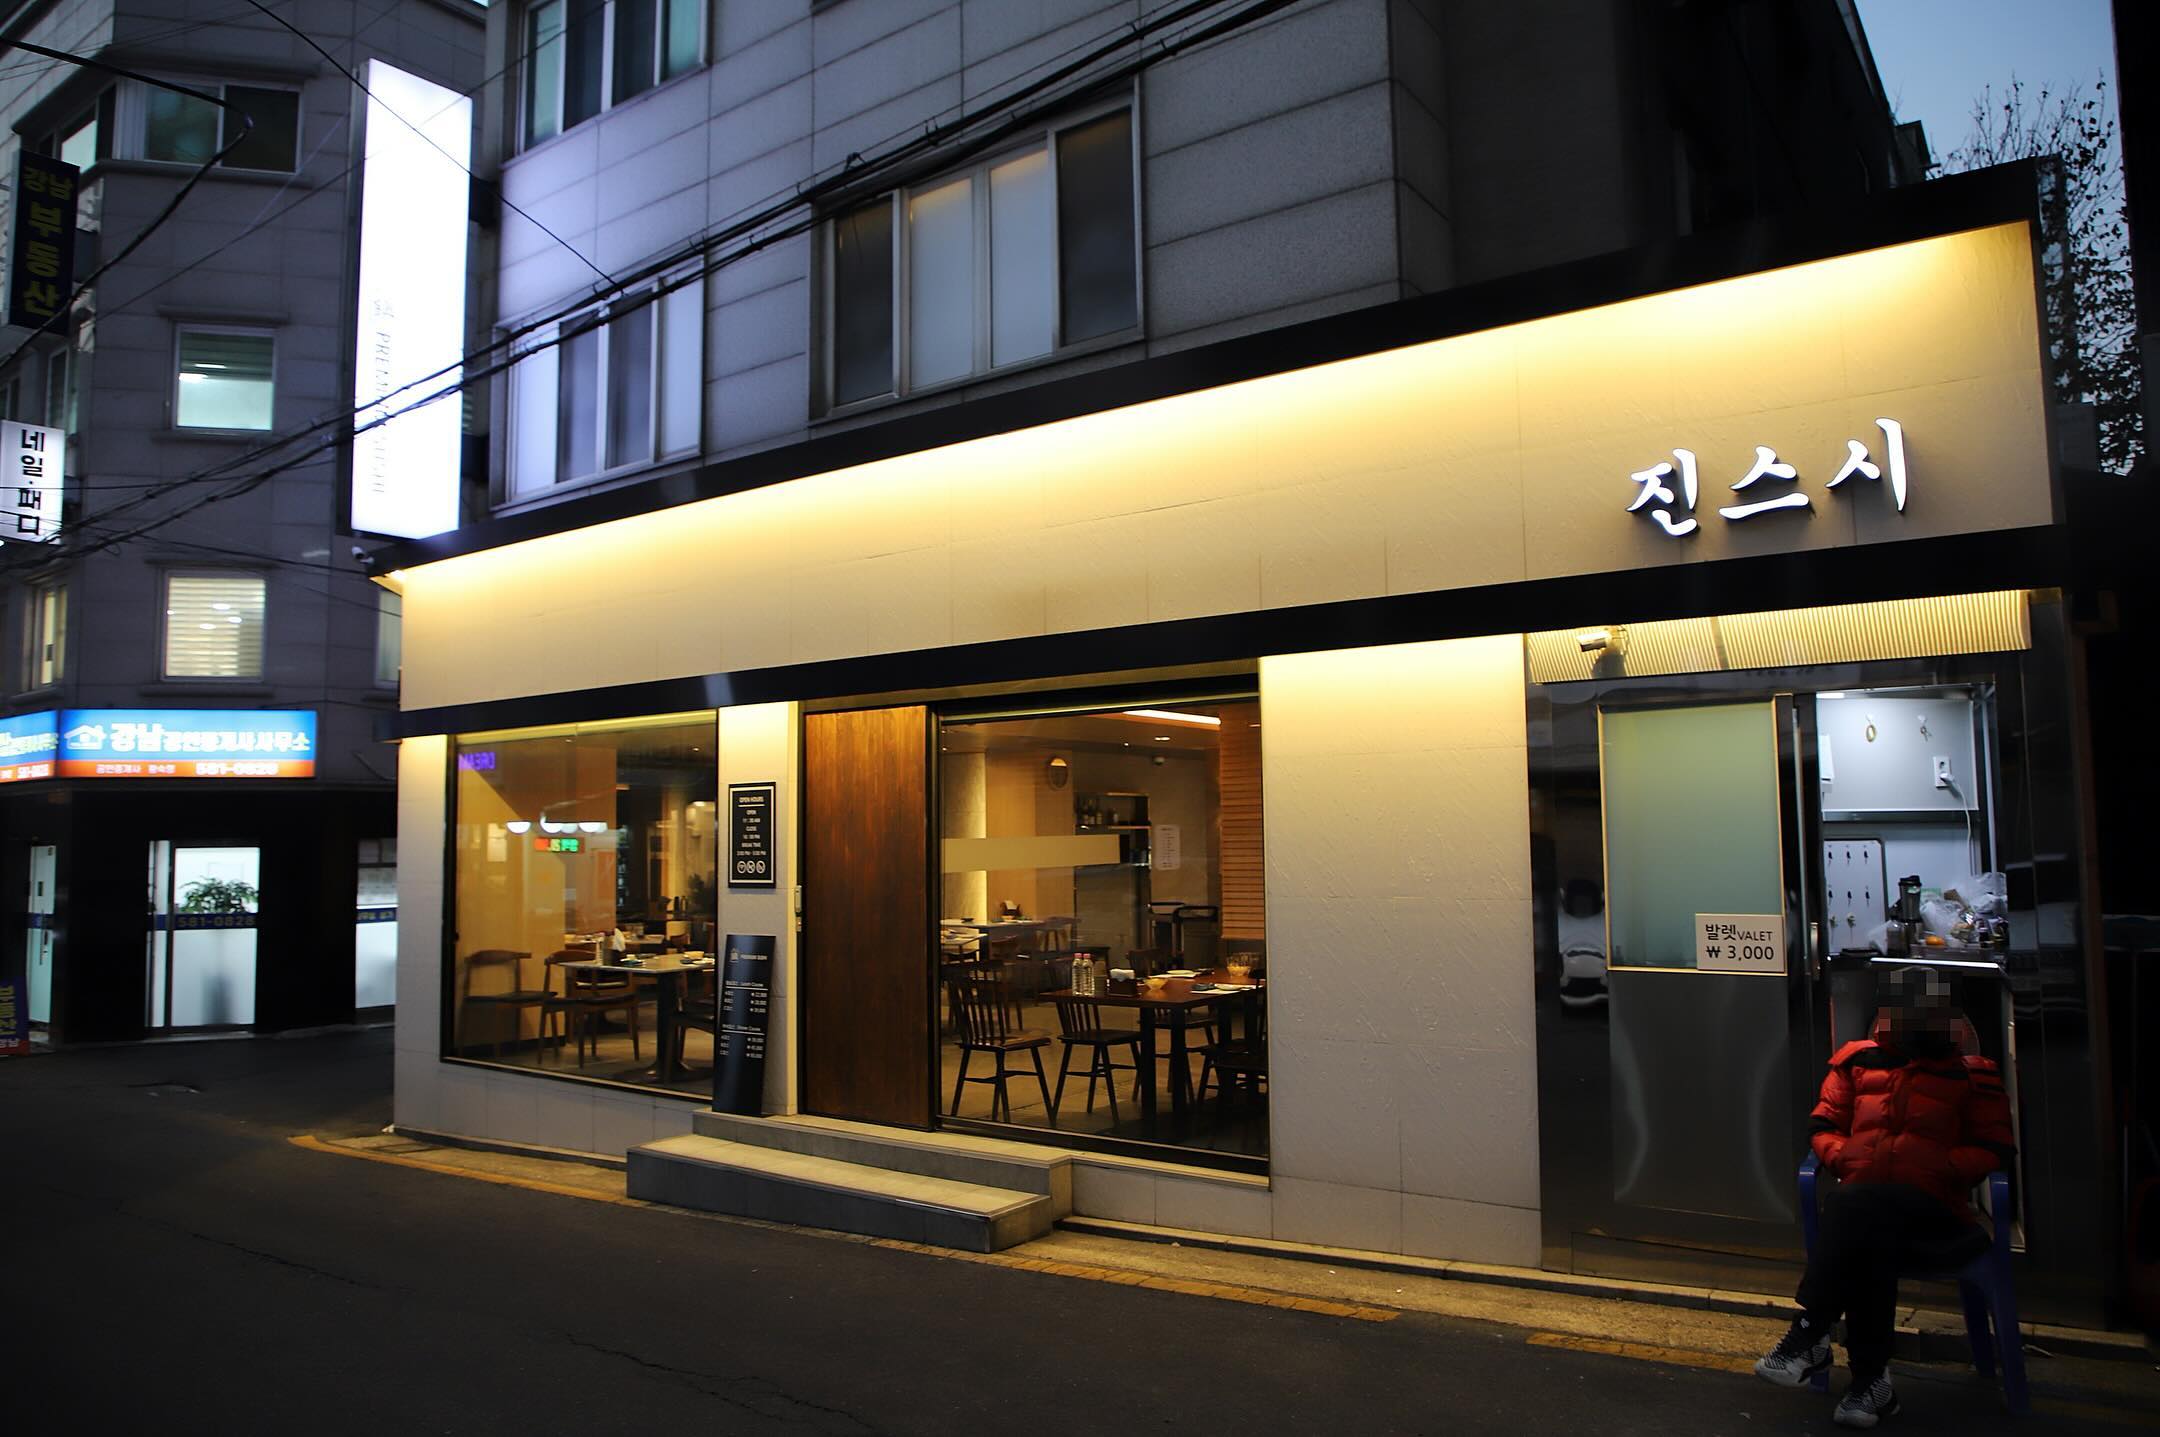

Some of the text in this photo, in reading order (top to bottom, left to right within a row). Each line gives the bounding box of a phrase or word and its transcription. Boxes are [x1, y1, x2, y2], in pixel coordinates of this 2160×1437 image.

[22, 202, 64, 318] 부동산
[1625, 417, 1908, 537] 진스시
[1727, 945, 1774, 961] 3,000
